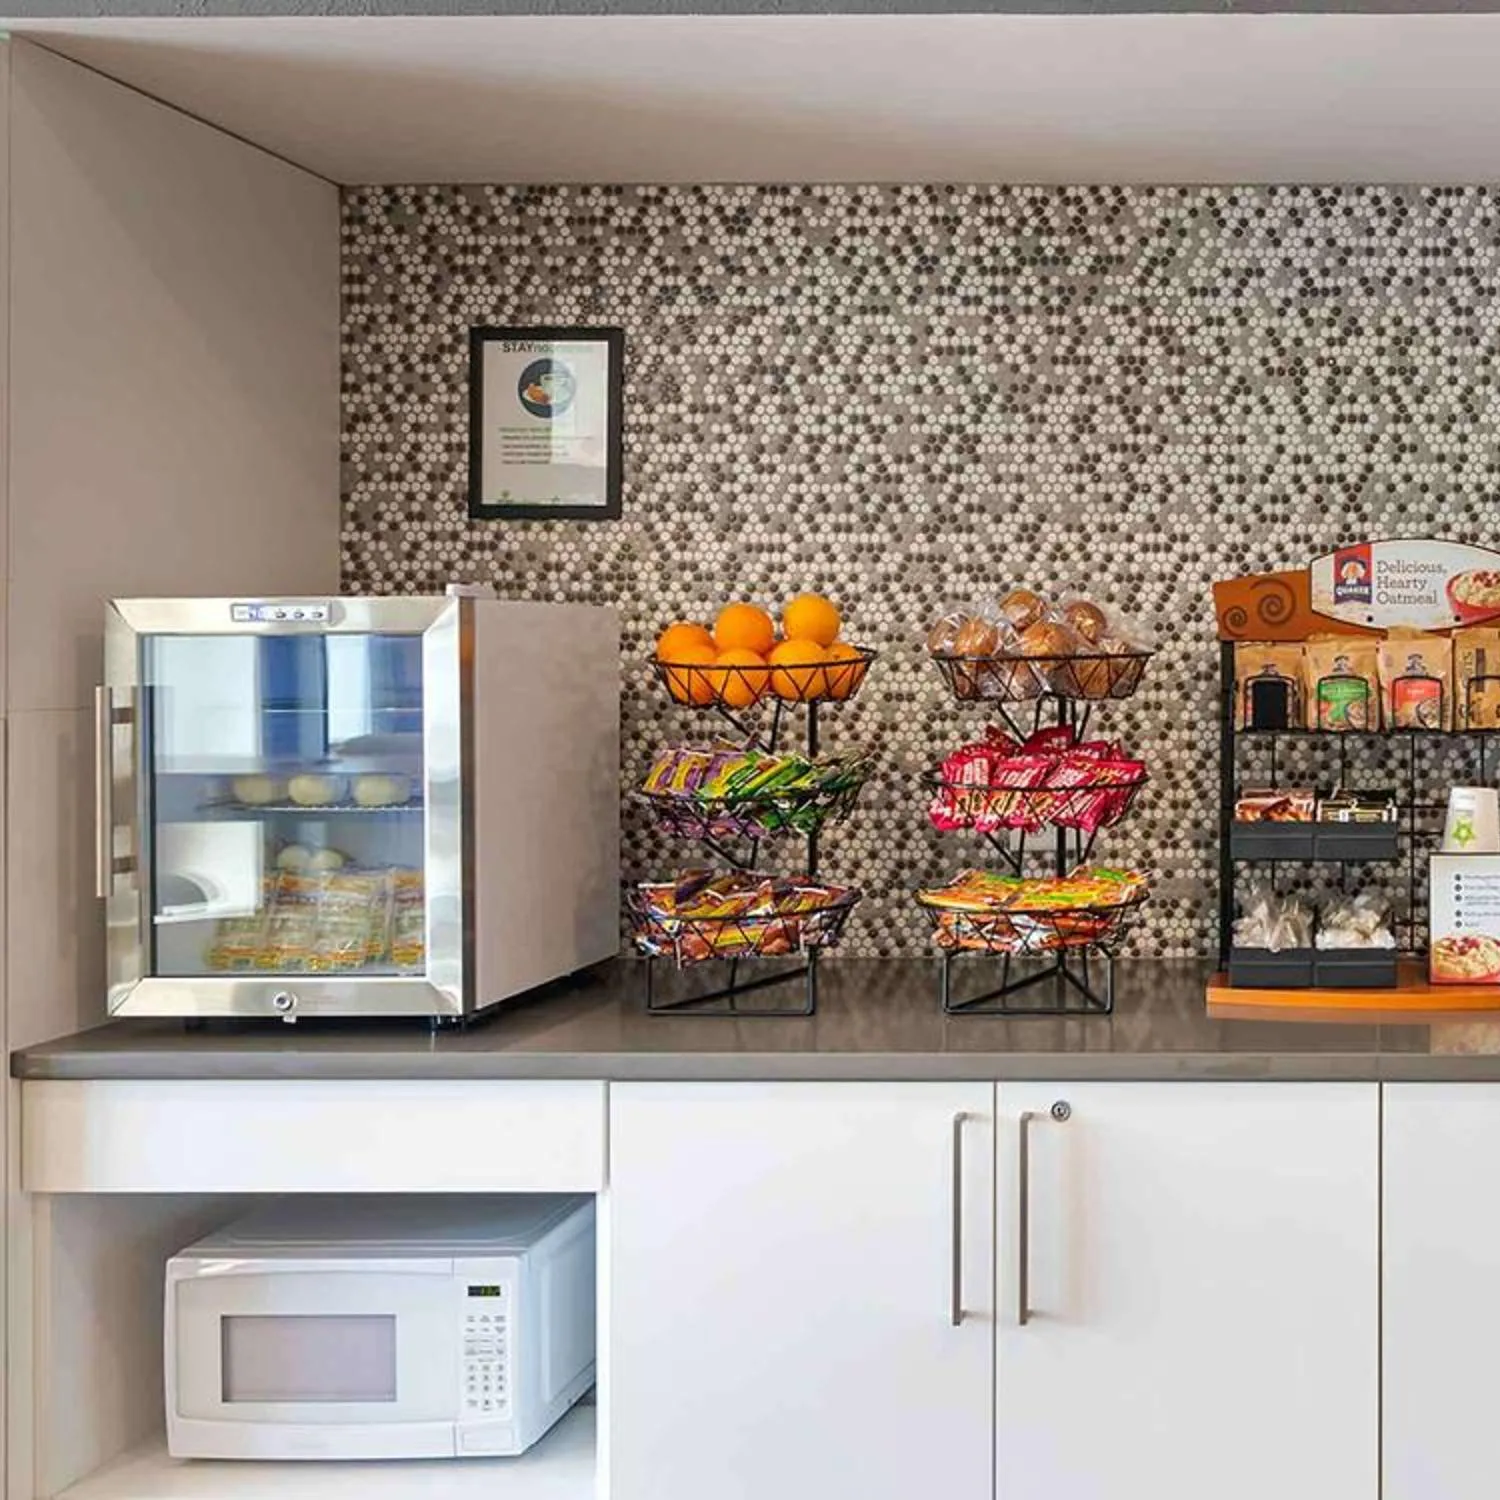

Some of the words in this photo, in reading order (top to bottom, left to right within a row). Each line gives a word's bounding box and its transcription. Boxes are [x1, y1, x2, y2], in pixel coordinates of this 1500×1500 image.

[1377, 559, 1447, 575] Delicious,
[1377, 575, 1428, 592] Hearty
[1376, 589, 1437, 605] Oatmeal
